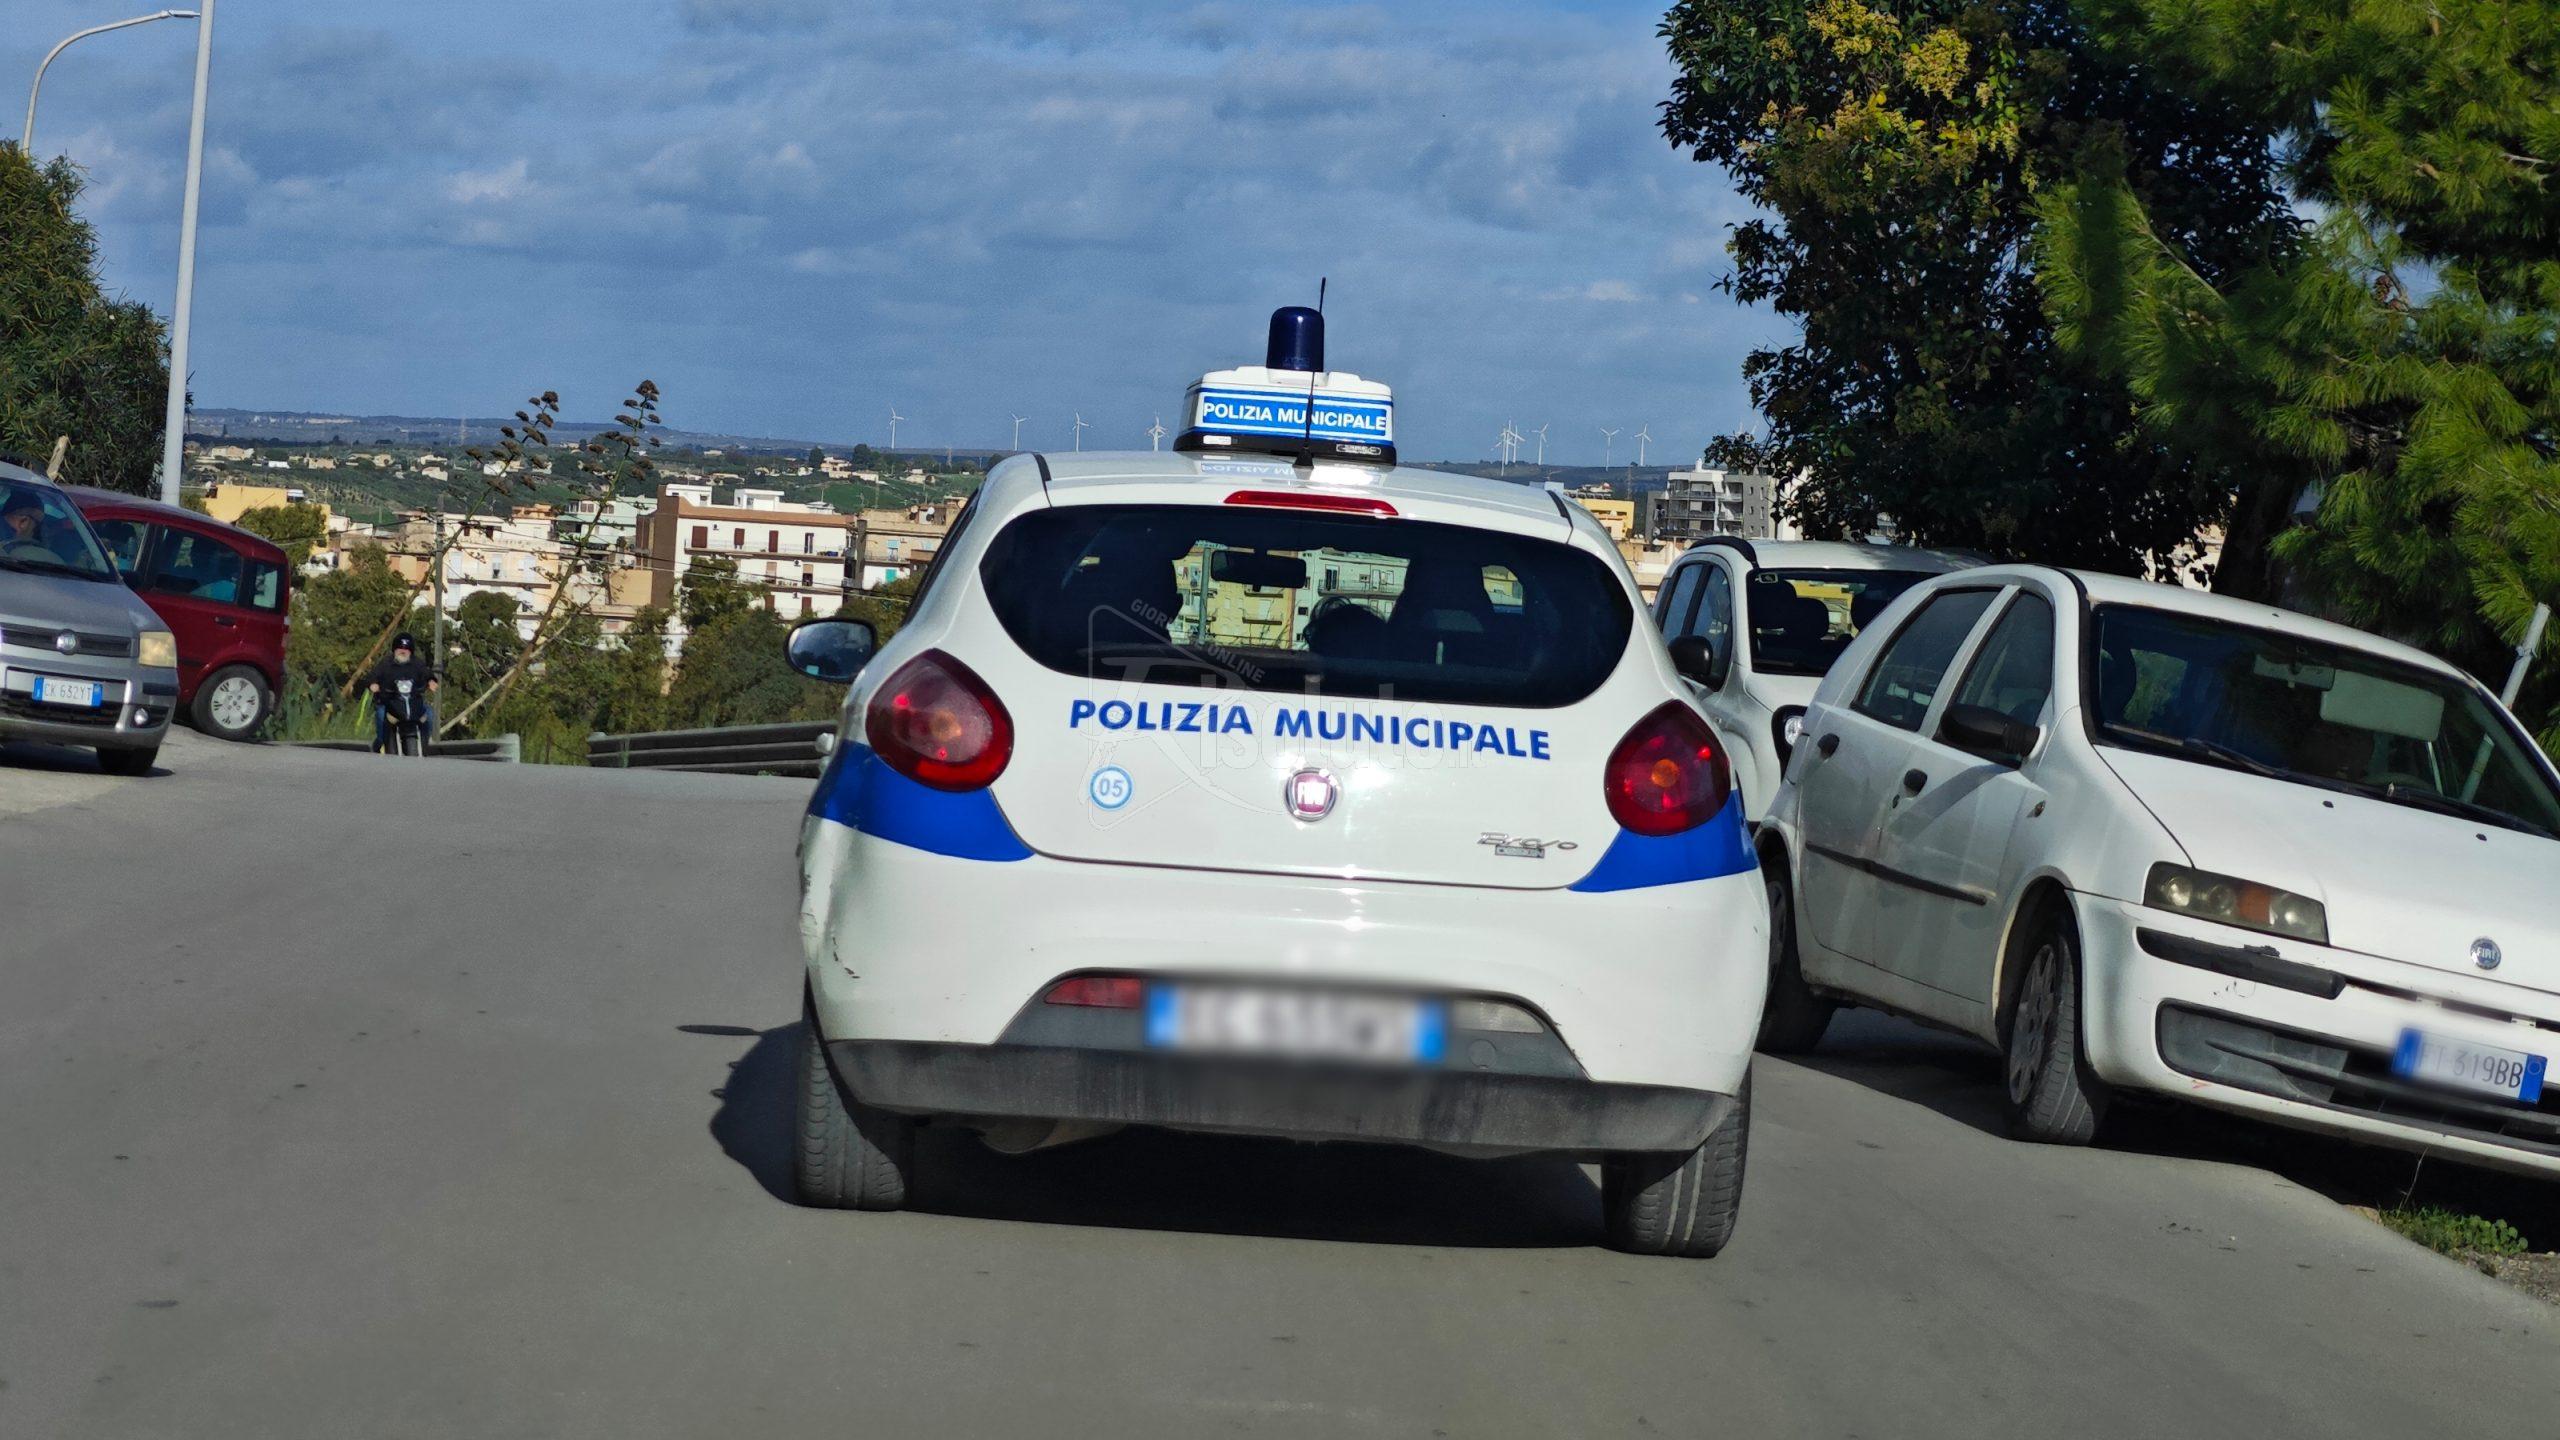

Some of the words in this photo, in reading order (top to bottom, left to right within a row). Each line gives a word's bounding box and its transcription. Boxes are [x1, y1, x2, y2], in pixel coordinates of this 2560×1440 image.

[1204, 403, 1272, 422] POLIZIA
[1278, 409, 1386, 431] MUNICIPALE
[1070, 699, 1253, 735] POLIZIA
[1275, 708, 1551, 760] MUNICIPALE
[1100, 778, 1123, 798] 05
[2454, 1050, 2524, 1088] 319BB
